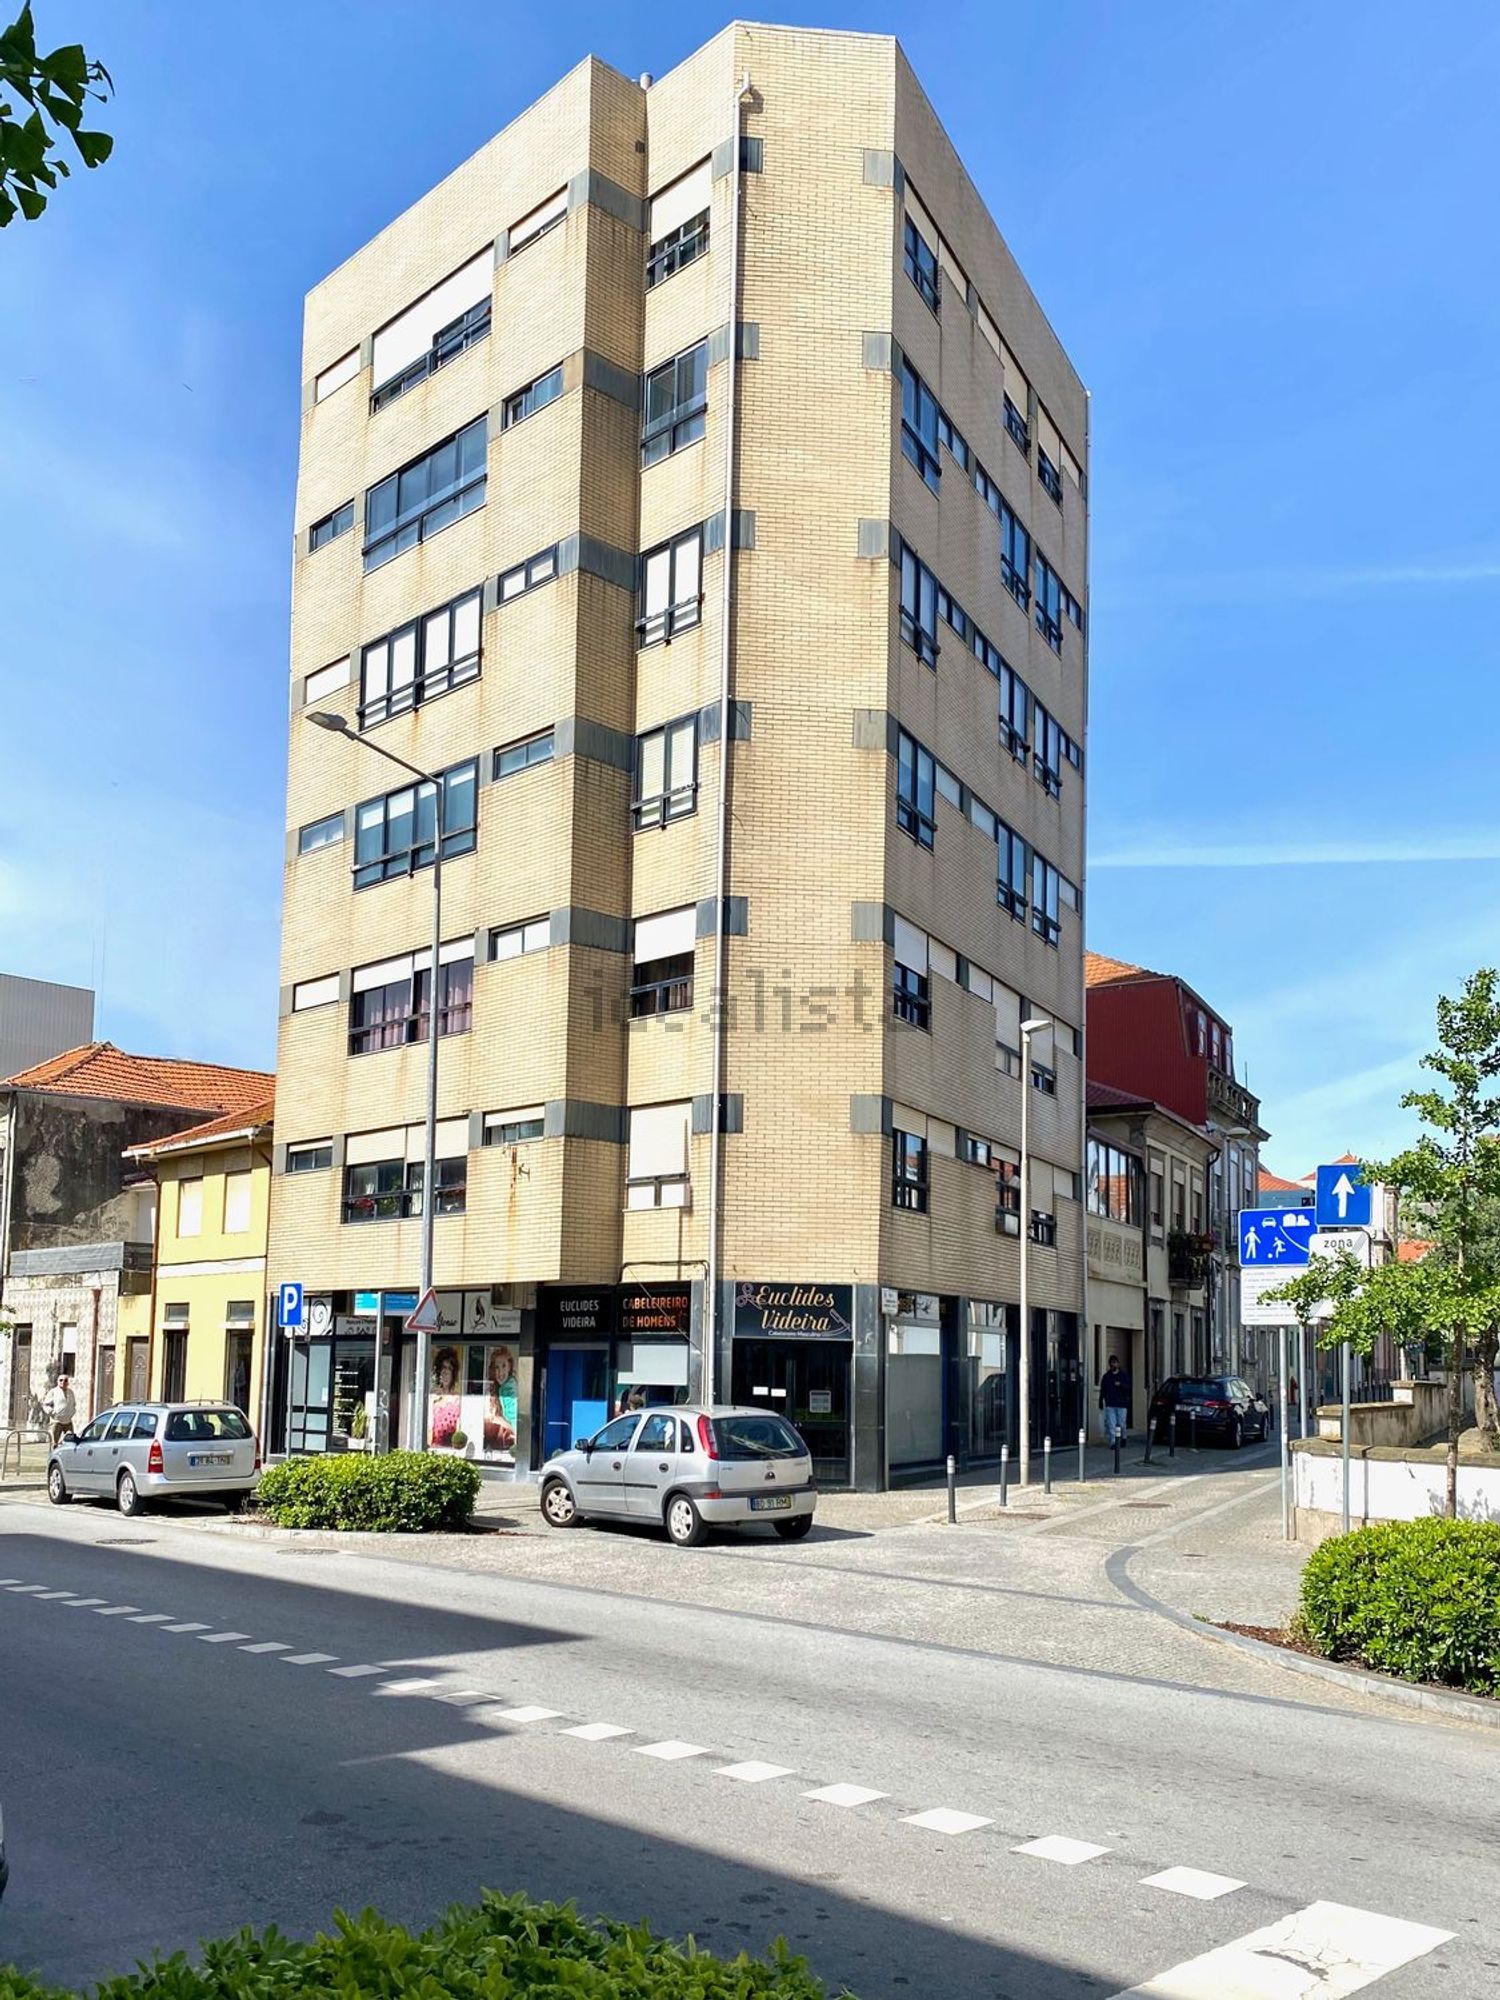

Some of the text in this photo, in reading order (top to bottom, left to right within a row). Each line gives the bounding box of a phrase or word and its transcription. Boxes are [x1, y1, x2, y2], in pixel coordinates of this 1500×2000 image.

[1324, 1239, 1353, 1248] zona
[622, 1296, 688, 1309] CABELEIREIRO
[756, 1285, 835, 1308] Euclides
[283, 1286, 298, 1323] P
[560, 1299, 599, 1312] EUCLIDES
[562, 1315, 596, 1328] VIDEIRA
[622, 1314, 676, 1328] DE HOMENS
[761, 1309, 831, 1331] Videira
